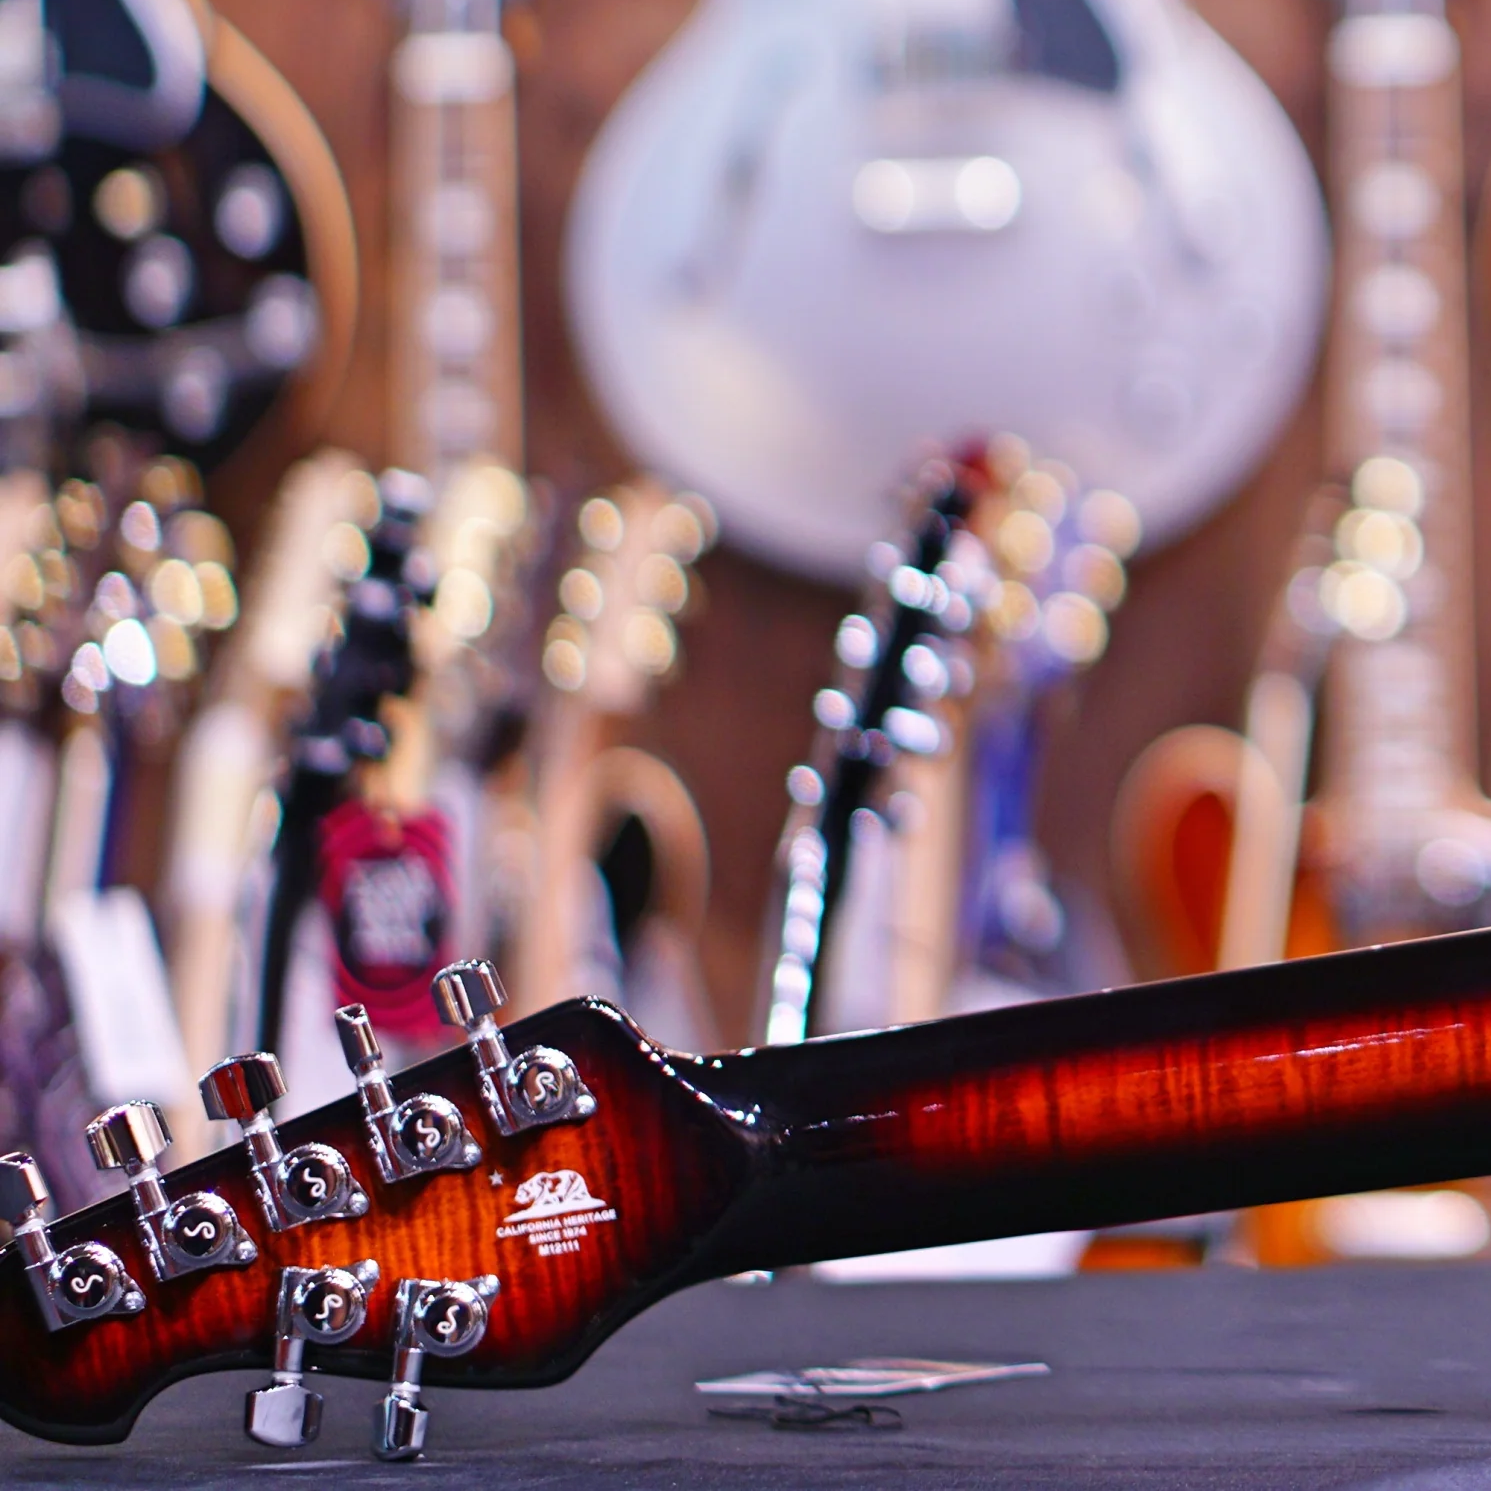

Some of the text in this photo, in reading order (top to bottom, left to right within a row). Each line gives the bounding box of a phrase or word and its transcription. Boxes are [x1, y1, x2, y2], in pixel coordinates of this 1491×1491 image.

[496, 1208, 617, 1238] CALIFORNIA HERITAGE
[528, 1229, 561, 1245] SINCE
